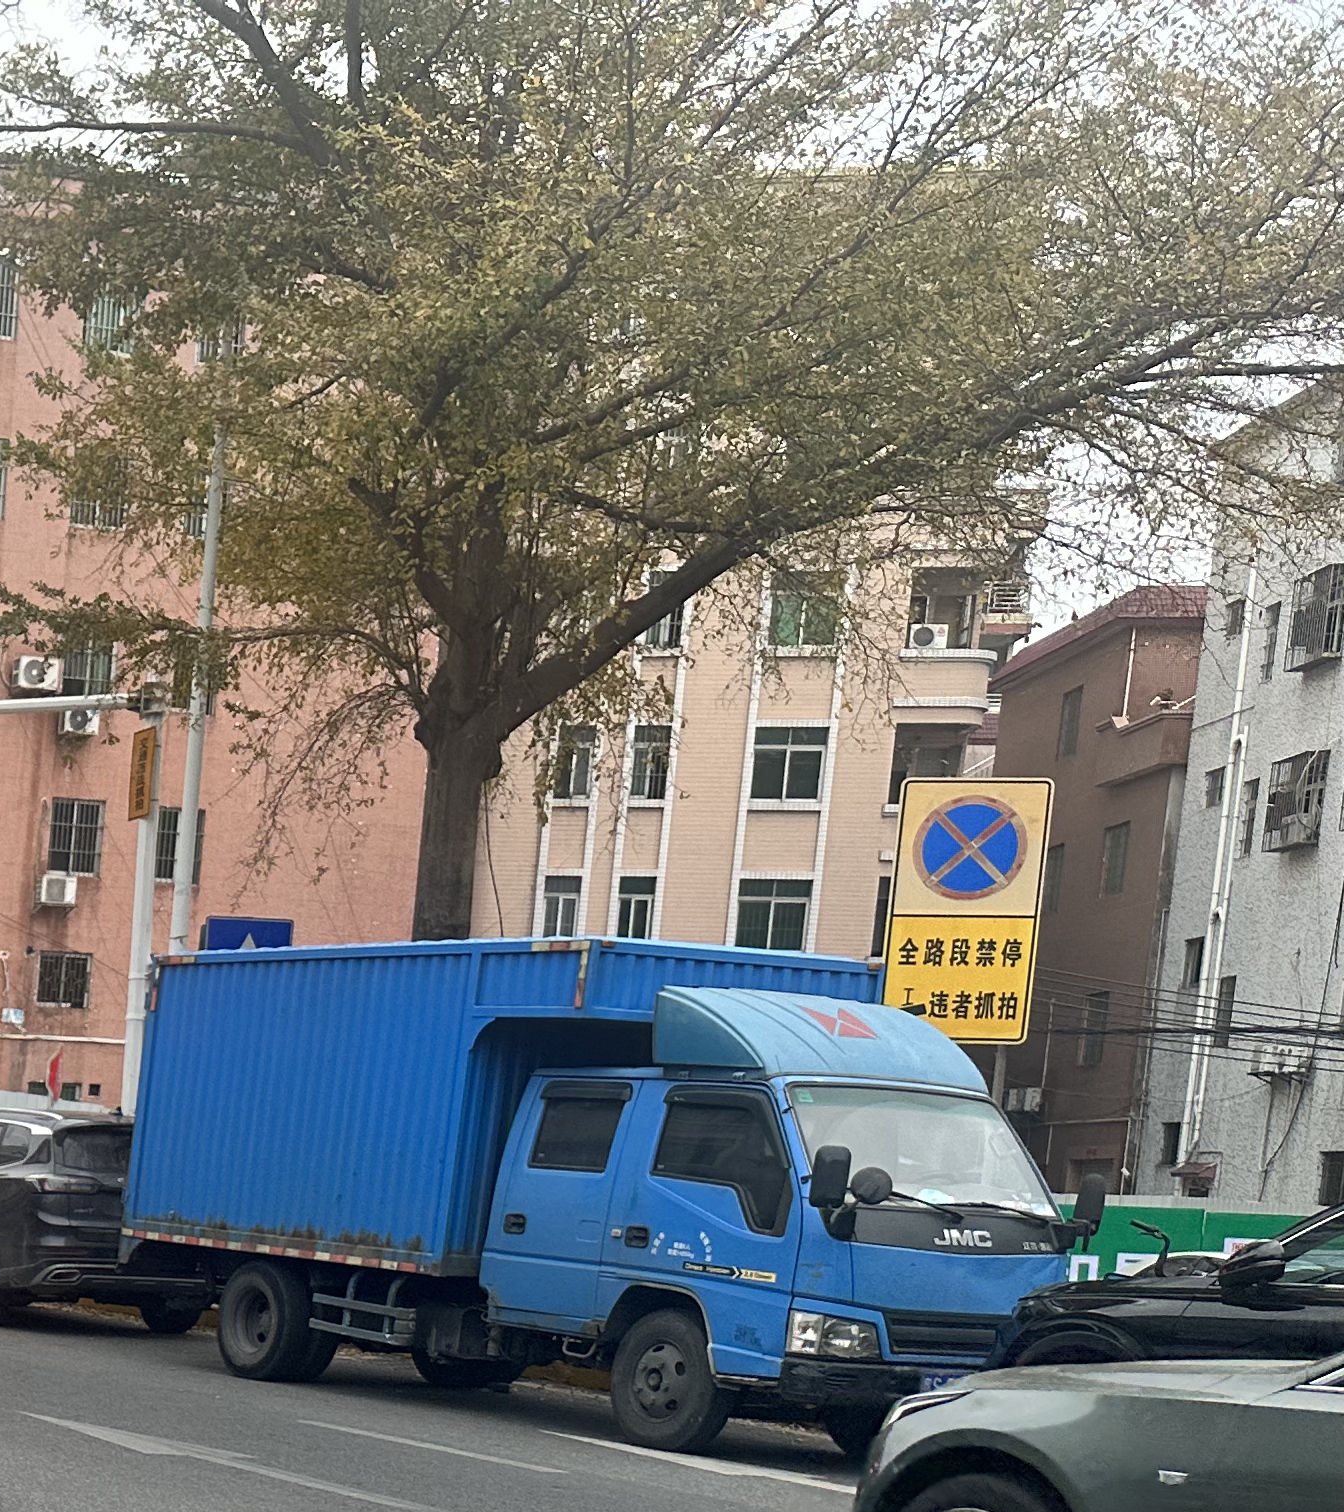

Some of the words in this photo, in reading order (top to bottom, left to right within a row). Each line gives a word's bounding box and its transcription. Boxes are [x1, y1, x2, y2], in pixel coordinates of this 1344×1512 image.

[898, 937, 1023, 967] 全路段禁停
[928, 991, 1018, 1020] 违者抓拍
[933, 1228, 993, 1248] JMC
